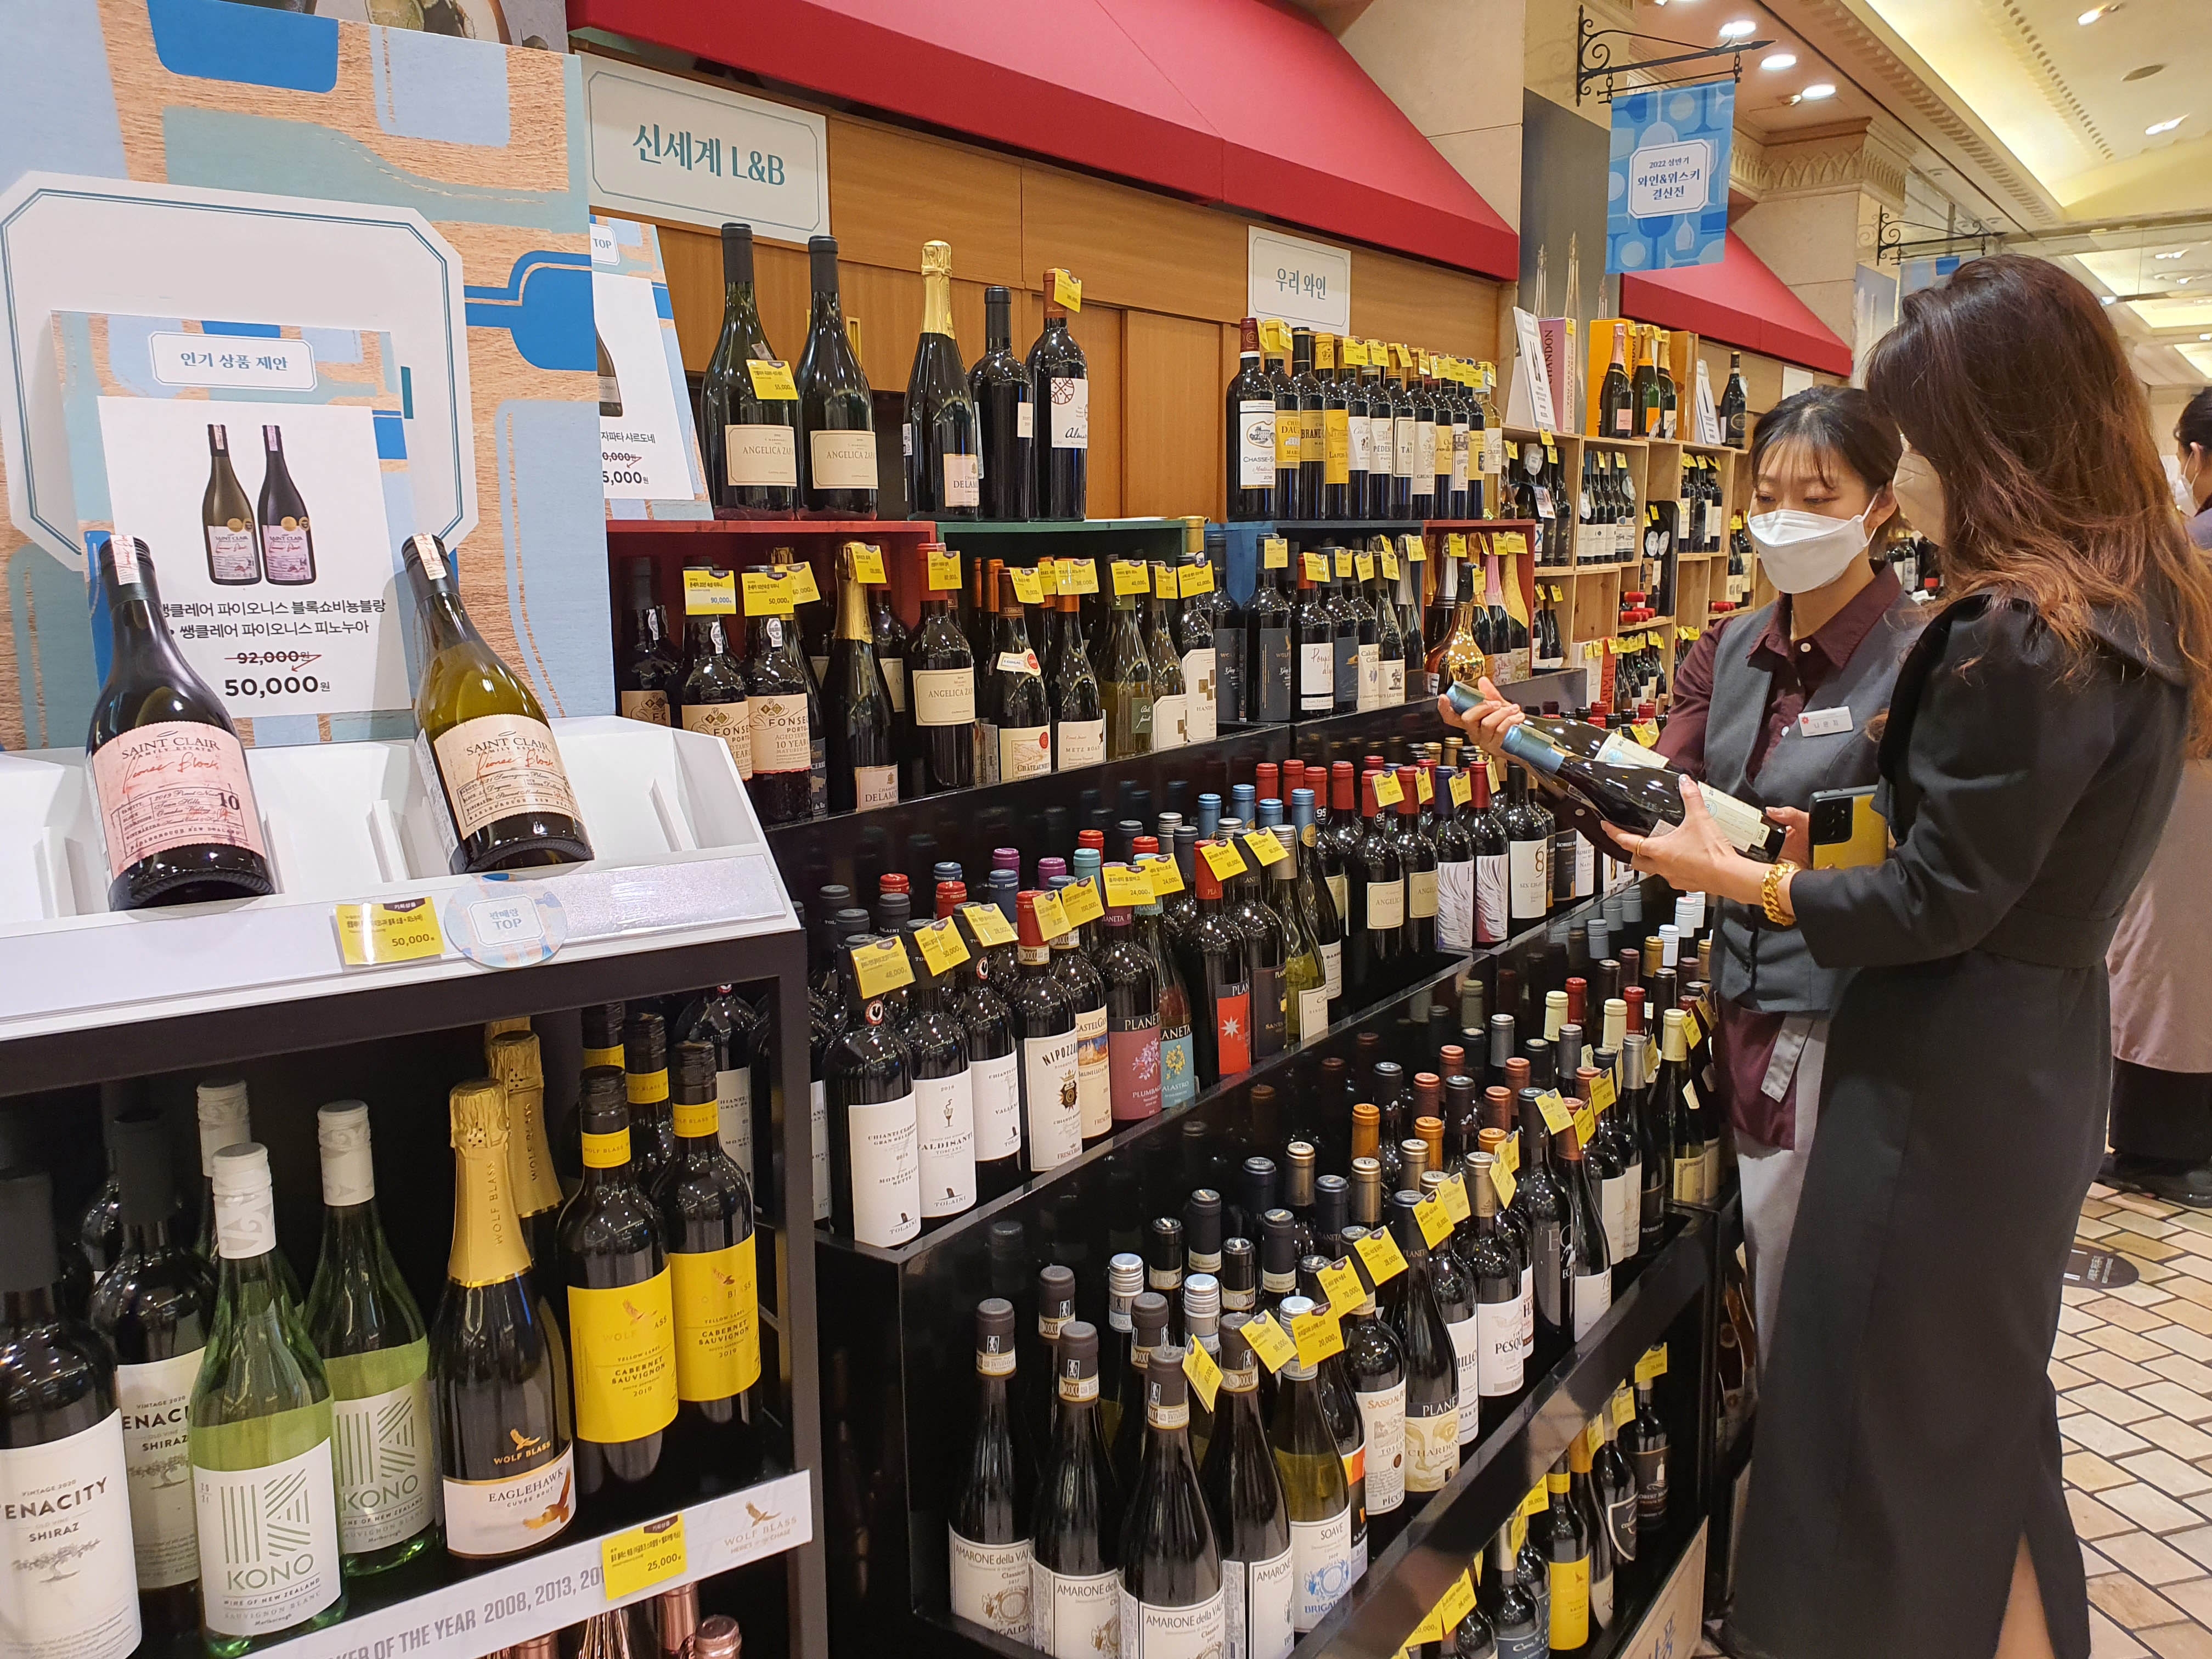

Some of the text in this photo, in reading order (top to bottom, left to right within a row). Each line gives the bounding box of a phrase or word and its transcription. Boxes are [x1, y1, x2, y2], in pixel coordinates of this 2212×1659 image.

[633, 125, 785, 185] 신세계 L&B
[1649, 157, 1689, 169] 2022 상반기
[1638, 169, 1700, 187] 와인&위스키
[592, 238, 611, 249] TOP
[1276, 268, 1326, 300] 우리 와인
[180, 352, 288, 371] 인기 상품 제안
[601, 431, 624, 442] 자파타
[743, 447, 781, 455] ANGELICA
[218, 602, 289, 616] 파이오니스
[291, 600, 386, 614] 블록쇼비뇽블랑
[180, 620, 368, 639] 쌩클레어 파이오니스 피노누아
[122, 737, 221, 759] SAINT CLAIR
[466, 738, 551, 756] SAINT CLAIR
[219, 793, 240, 810] 10
[1317, 808, 1327, 818] 95
[493, 919, 521, 929] TOP
[868, 1131, 899, 1140] CHIANTI
[487, 1160, 503, 1246] WOLF BLASS
[934, 1196, 966, 1207] TOLAINI
[699, 1325, 749, 1345] SAUVIGNON
[702, 1319, 747, 1338] CABERNET
[618, 1346, 660, 1362] YELLOW LABEL
[719, 1348, 737, 1358] 2019
[612, 1363, 665, 1384] SAUVIGNON
[615, 1356, 663, 1376] CABERNET
[634, 1386, 652, 1397] 2019
[137, 1396, 185, 1409] VINTAGE 2020
[142, 1435, 188, 1451] SHIRAZ
[494, 1440, 551, 1465] WOLF BLASS
[22, 1480, 76, 1496] VINTAGE 2020
[343, 1475, 418, 1511] KONO
[488, 1467, 563, 1503] EAGLEHAWK
[0, 1476, 108, 1519] ENACITY
[375, 1513, 391, 1521] NEW
[394, 1497, 423, 1515] ZEALAND
[29, 1522, 80, 1542] SHIRAZ
[724, 1517, 797, 1547] WOLF BLASS
[1321, 1523, 1344, 1540] SOAVE
[956, 1544, 1013, 1564] AMARONE della
[228, 1554, 314, 1590] KONO
[1002, 1571, 1025, 1579] Classico
[1257, 1557, 1291, 1581] AMARONE
[262, 1594, 281, 1603] NEW
[285, 1577, 320, 1597] ZEALAND
[1057, 1584, 1103, 1596] AMARONE
[374, 1637, 395, 1659] OF
[398, 1624, 431, 1653] THE
[434, 1610, 476, 1641] YEAR
[484, 1594, 531, 1625] 2008,
[535, 1575, 577, 1606] 2013,
[1147, 1610, 1211, 1628] AMARONE della
